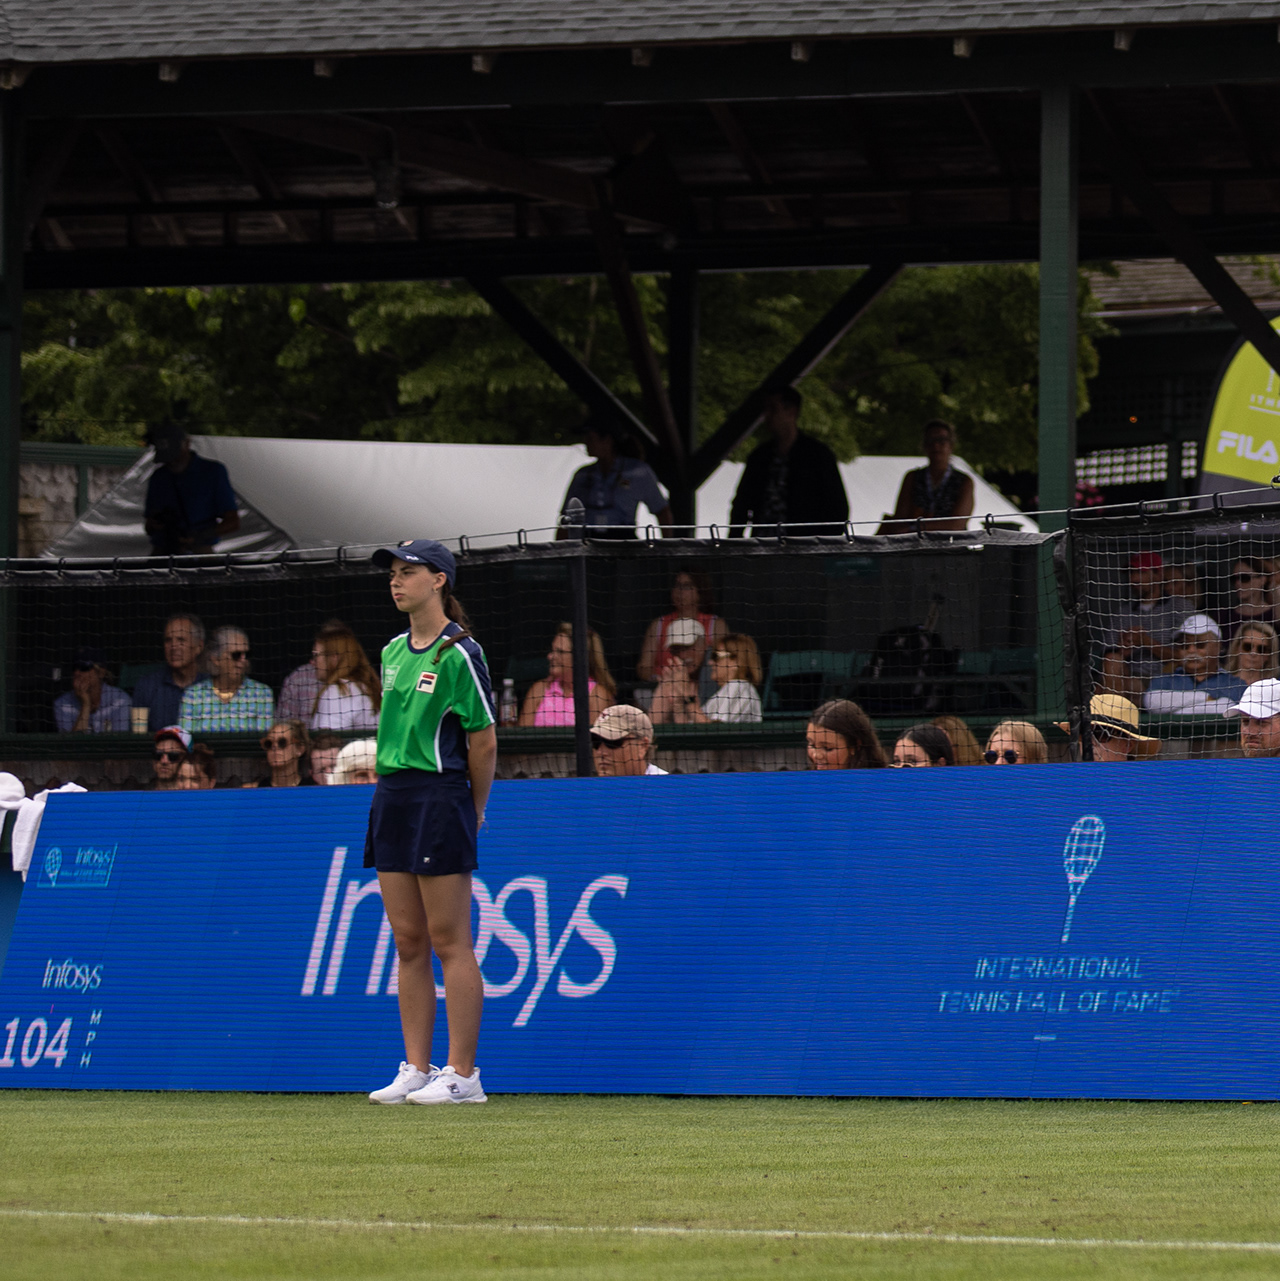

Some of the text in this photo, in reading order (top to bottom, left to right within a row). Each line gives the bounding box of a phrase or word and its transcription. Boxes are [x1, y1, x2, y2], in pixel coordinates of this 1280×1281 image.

[1217, 430, 1278, 464] FILA
[300, 846, 630, 1028] Insys
[42, 958, 103, 994] Infosys
[975, 957, 1142, 979] INTERNATIONAL
[939, 991, 1173, 1012] TENNIS HALL OF FAME
[0, 1017, 73, 1068] 104
